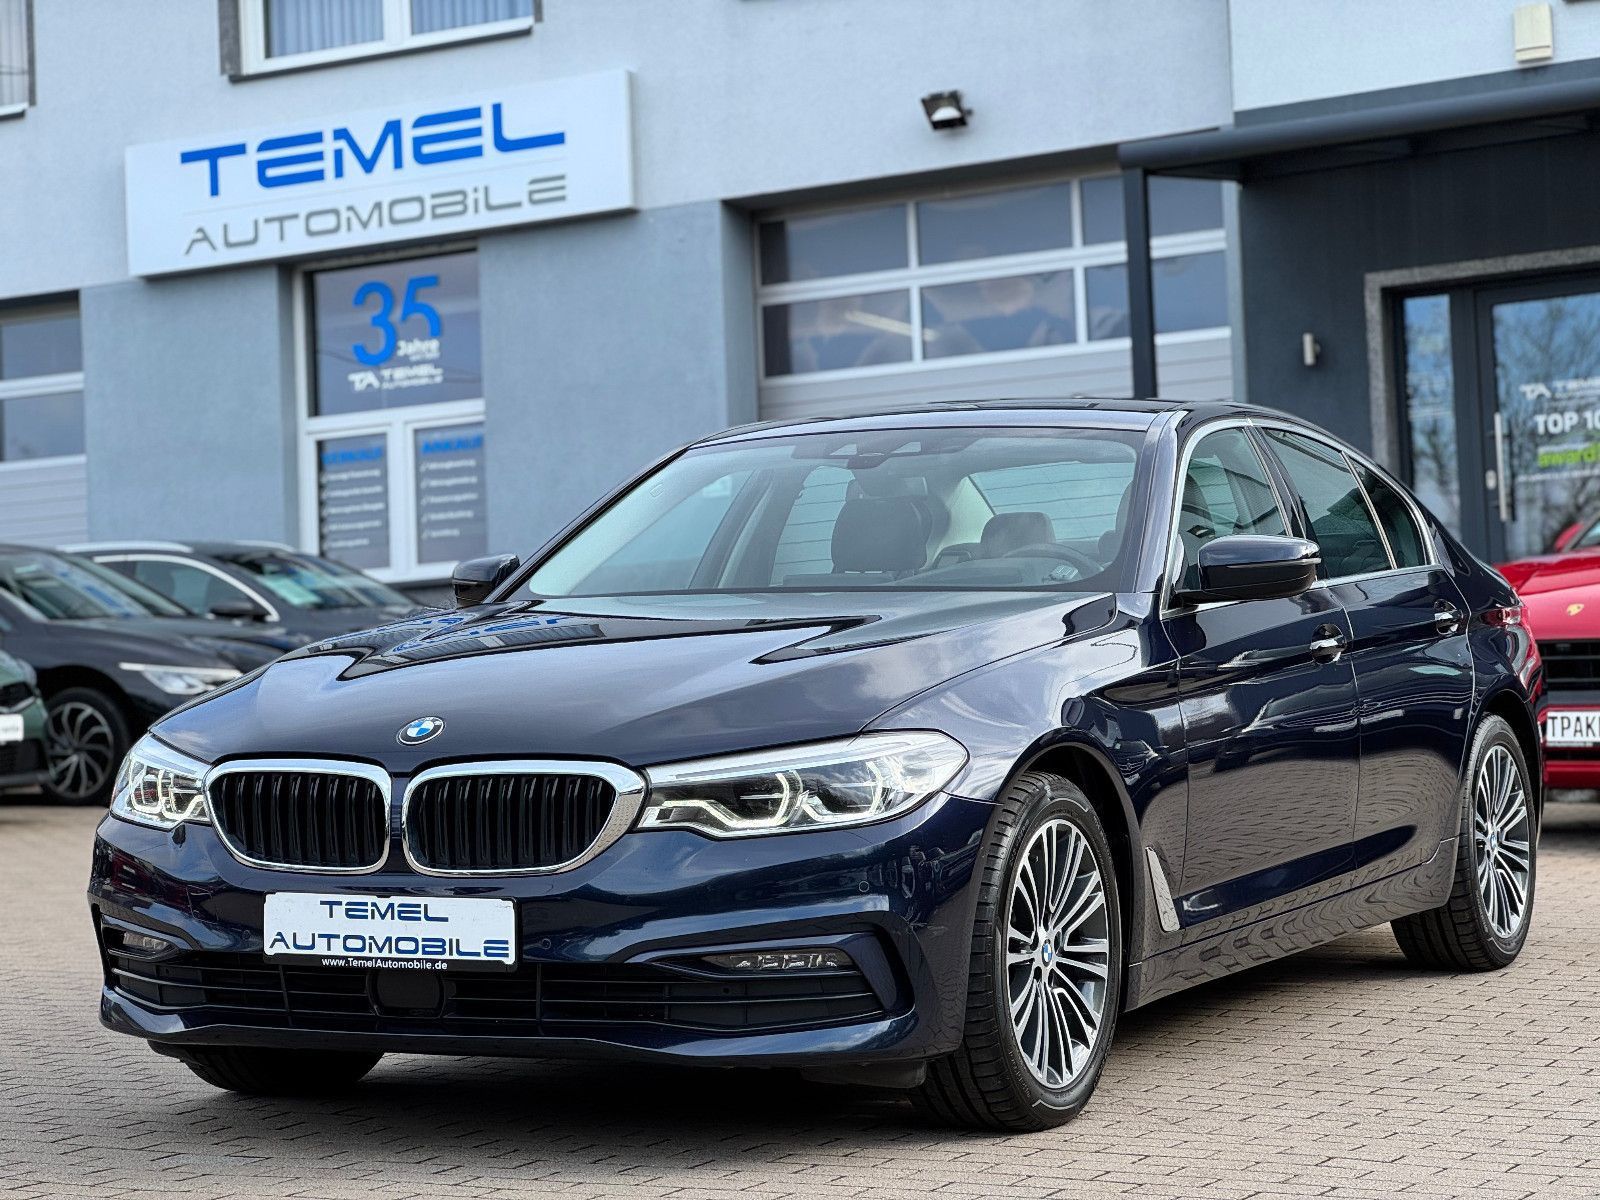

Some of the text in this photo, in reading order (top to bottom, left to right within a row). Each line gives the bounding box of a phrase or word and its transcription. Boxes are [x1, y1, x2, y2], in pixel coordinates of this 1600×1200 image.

[180, 102, 566, 197] TEMEL
[352, 274, 442, 367] 35
[1533, 411, 1579, 435] TOP
[319, 899, 449, 923] TEMEL
[268, 931, 511, 959] AUTOMOBILE
[321, 957, 448, 971] www.TemelAutomobile.de
